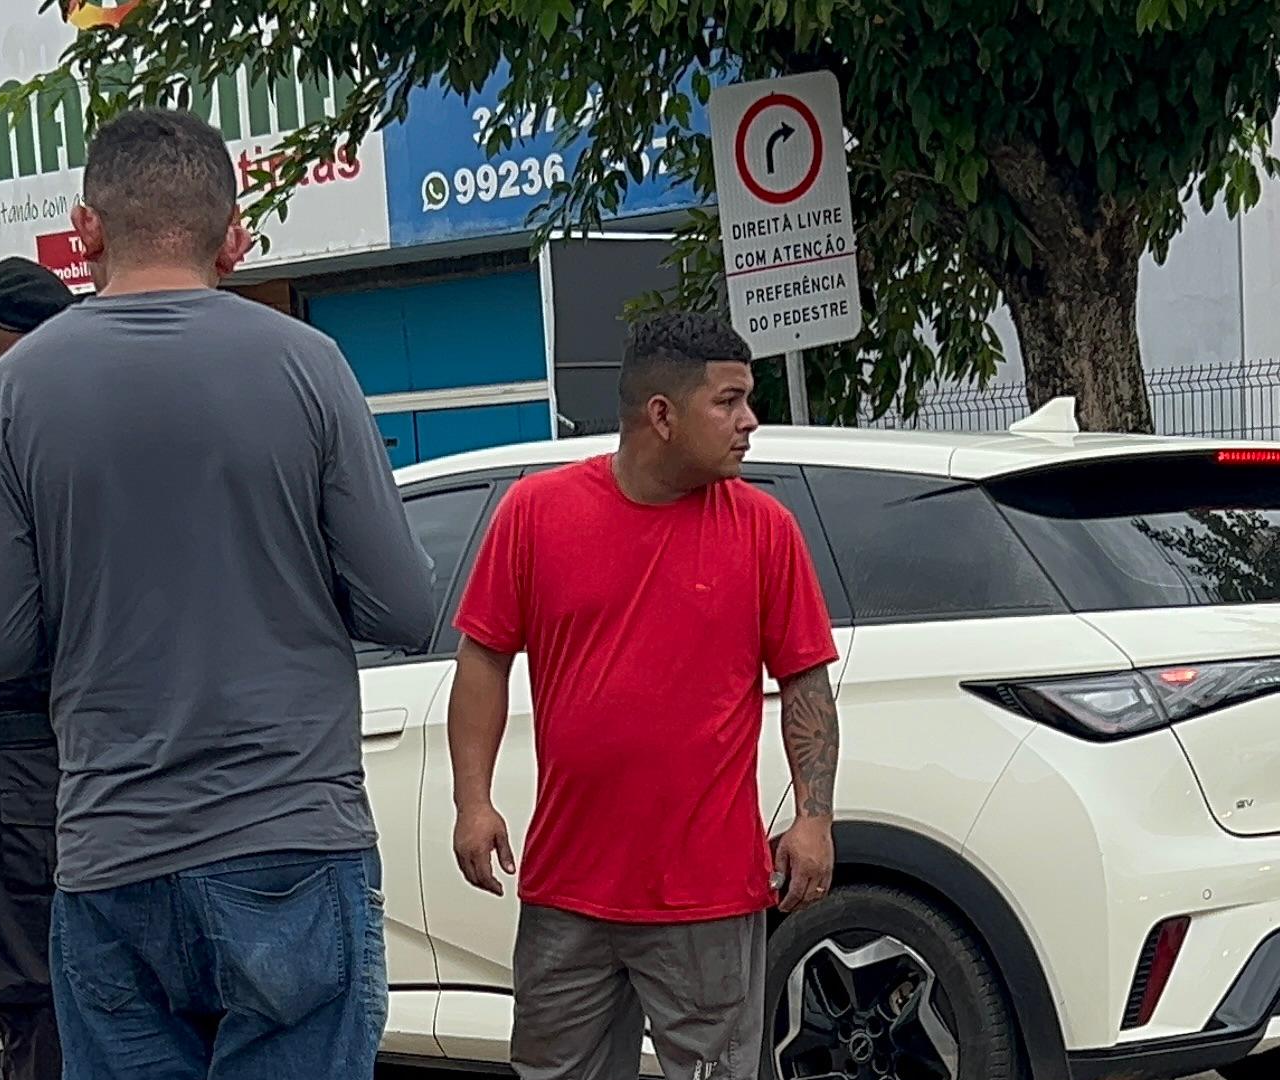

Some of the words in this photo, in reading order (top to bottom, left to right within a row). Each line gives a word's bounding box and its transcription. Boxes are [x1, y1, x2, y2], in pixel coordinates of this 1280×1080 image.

[453, 152, 566, 204] 99236
[42, 196, 68, 218] com
[732, 213, 793, 240] DIREITA
[798, 207, 842, 230] LIVRE
[735, 249, 767, 270] COM
[745, 273, 847, 305] PREFERÊNCIA
[749, 316, 769, 333] DO
[773, 300, 849, 328] PEDESTRE
